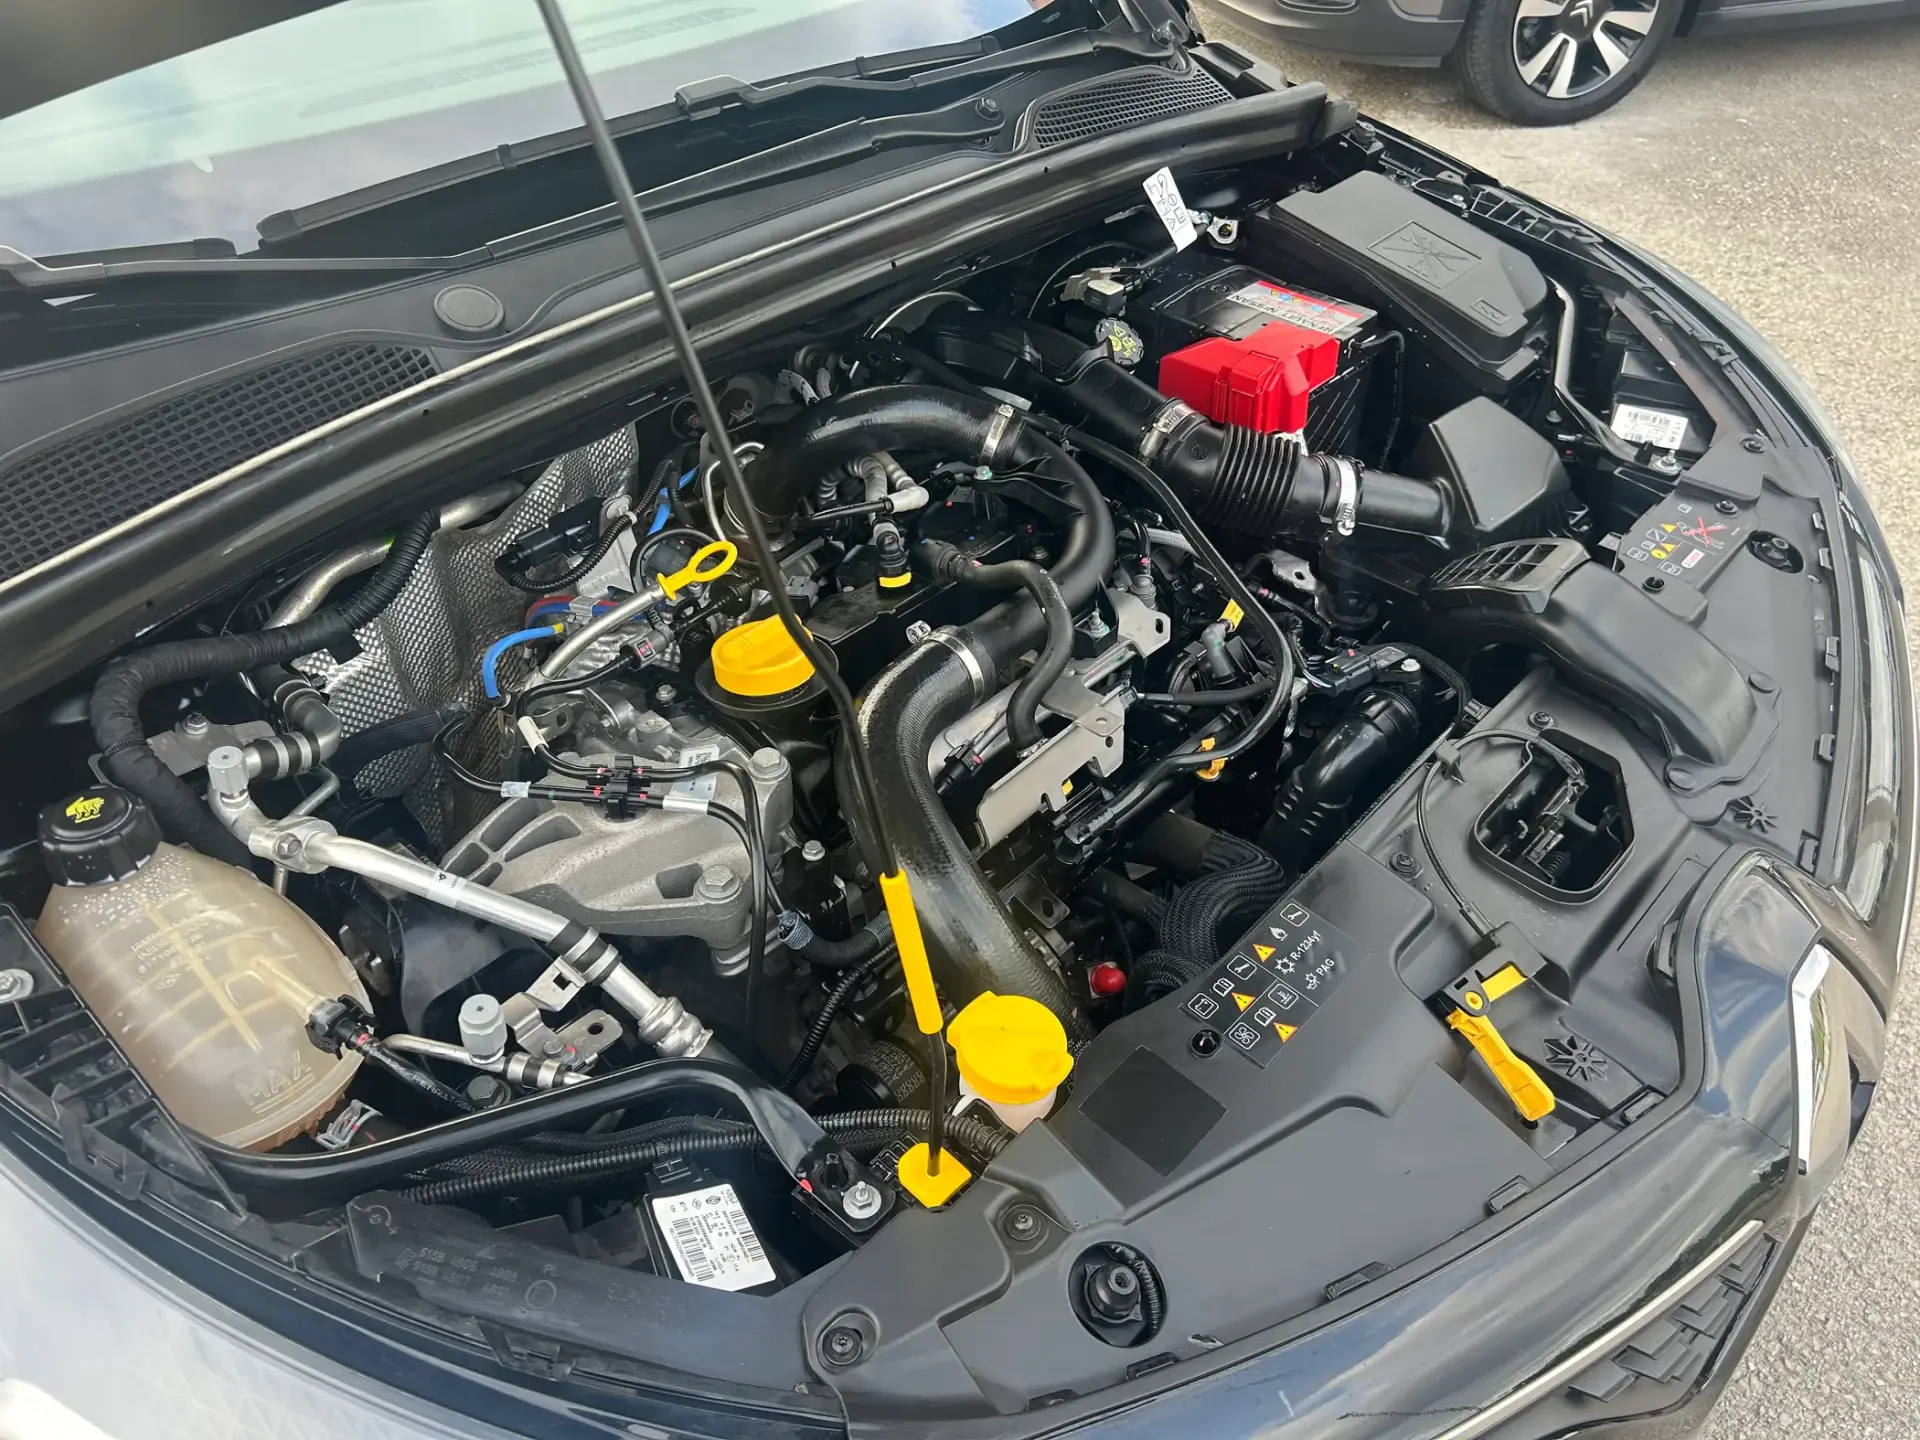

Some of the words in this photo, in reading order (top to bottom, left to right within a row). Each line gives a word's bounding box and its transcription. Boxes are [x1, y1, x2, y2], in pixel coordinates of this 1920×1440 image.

[1231, 293, 1278, 315] NISSAN
[1283, 312, 1335, 334] RENAULT
[1290, 930, 1321, 961] R-1234yf
[1315, 958, 1335, 976] PAG
